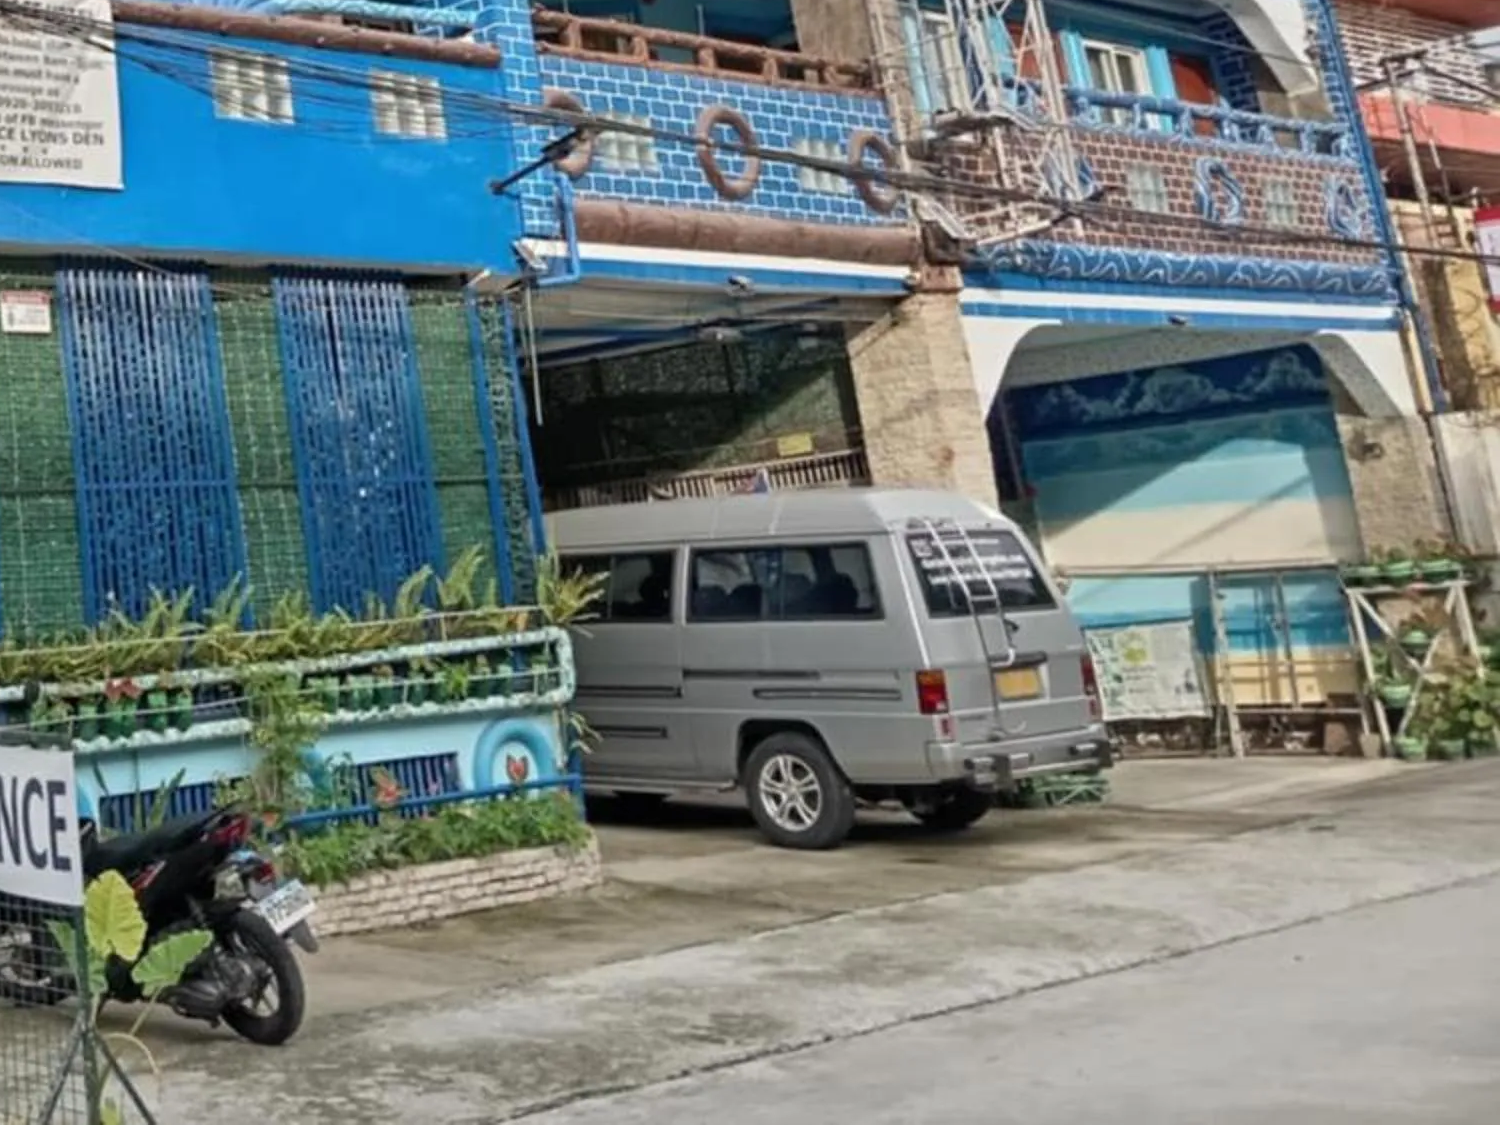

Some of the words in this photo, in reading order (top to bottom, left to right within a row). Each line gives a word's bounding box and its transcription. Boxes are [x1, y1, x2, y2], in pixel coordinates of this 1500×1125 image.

[20, 129, 69, 146] LYONS
[72, 131, 105, 147] DEN
[21, 156, 84, 171] ALLOWED
